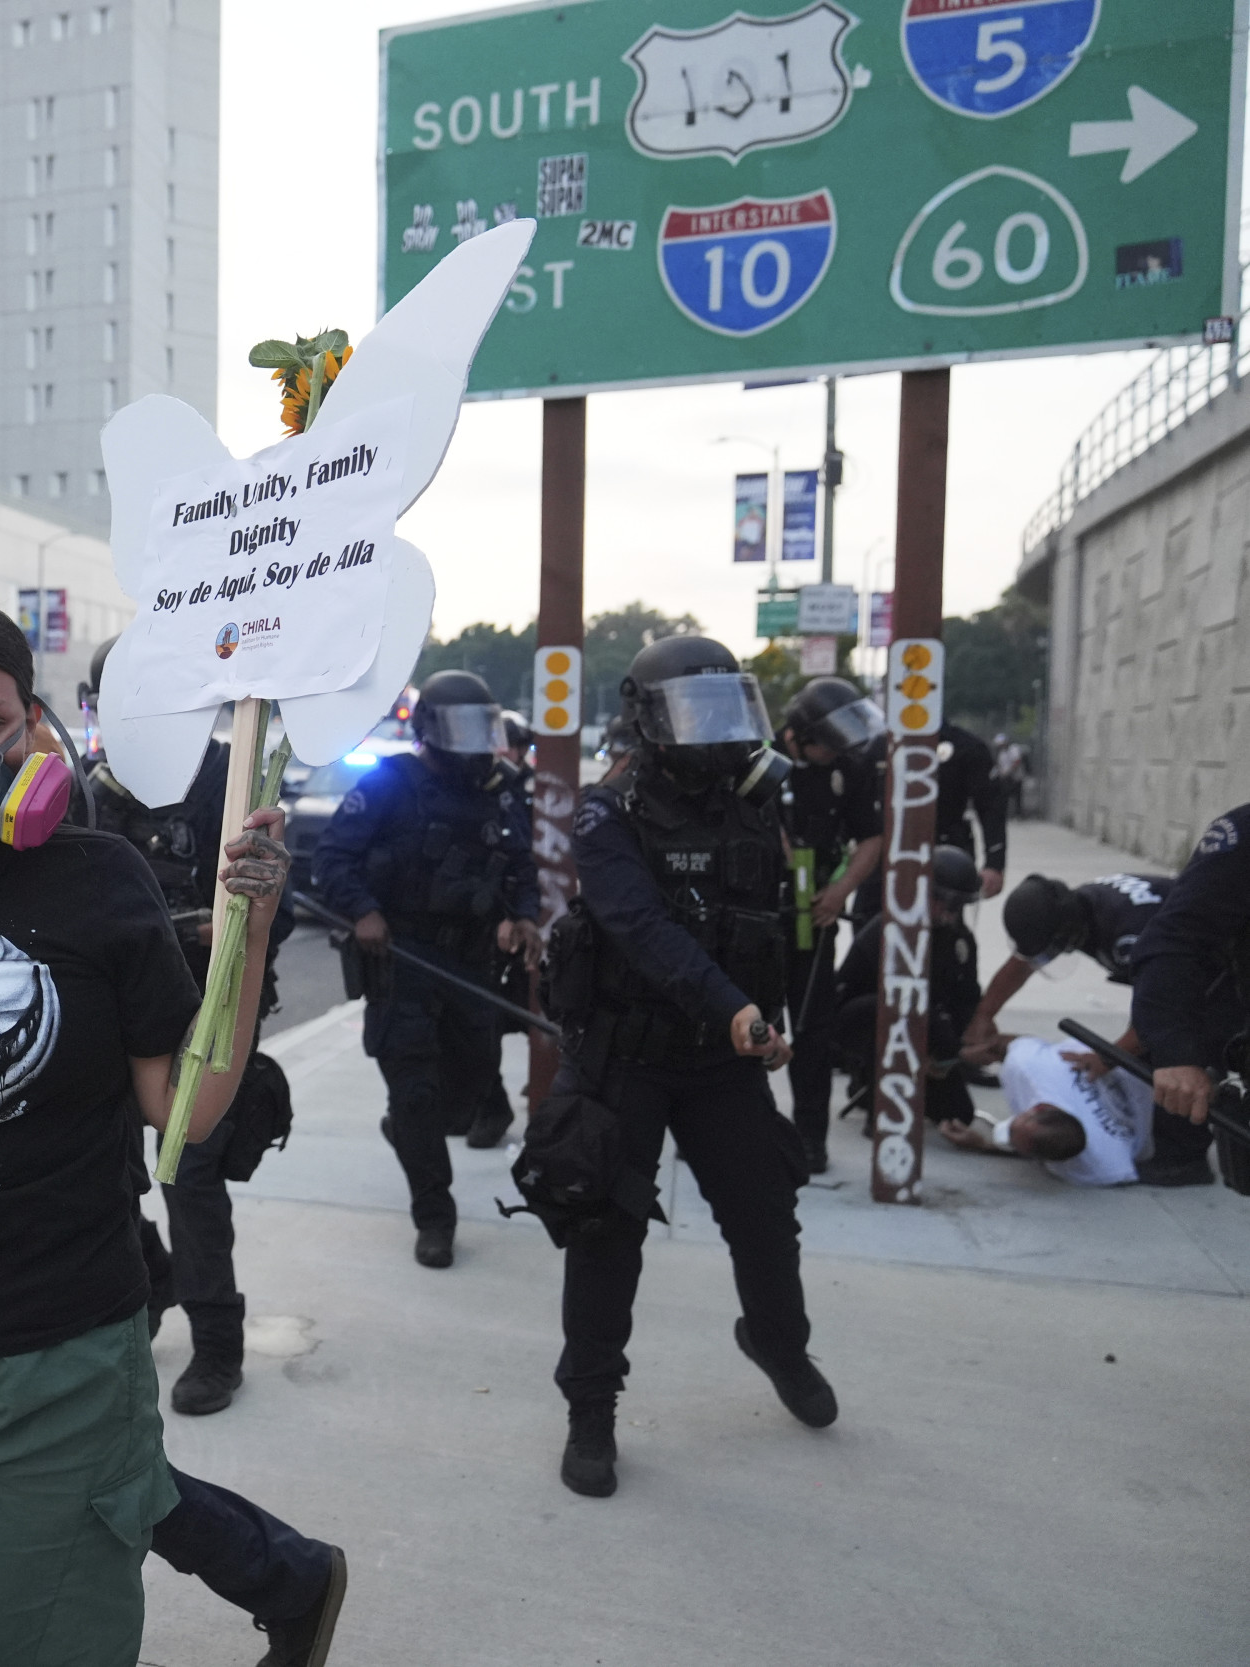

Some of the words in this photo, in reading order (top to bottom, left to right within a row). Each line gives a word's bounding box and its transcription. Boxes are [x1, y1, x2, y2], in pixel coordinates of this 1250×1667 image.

[974, 16, 1027, 94] 5
[412, 77, 601, 151] SOUTH
[581, 221, 632, 249] 2MC
[690, 206, 801, 234] INTERSTATE
[932, 211, 1049, 290] 60
[505, 260, 574, 313] ST
[703, 239, 792, 312] 10
[172, 489, 238, 527] Family
[242, 473, 298, 508] Unity,
[305, 443, 379, 490] Family
[229, 516, 301, 556] Dignity
[153, 588, 188, 613] Soy
[188, 582, 212, 605] de
[215, 567, 258, 602] Aqui,
[262, 561, 304, 589] Soy
[306, 551, 331, 579] de
[333, 539, 376, 572] Alla
[241, 616, 281, 636] CHIRLA
[672, 860, 706, 872] POICE
